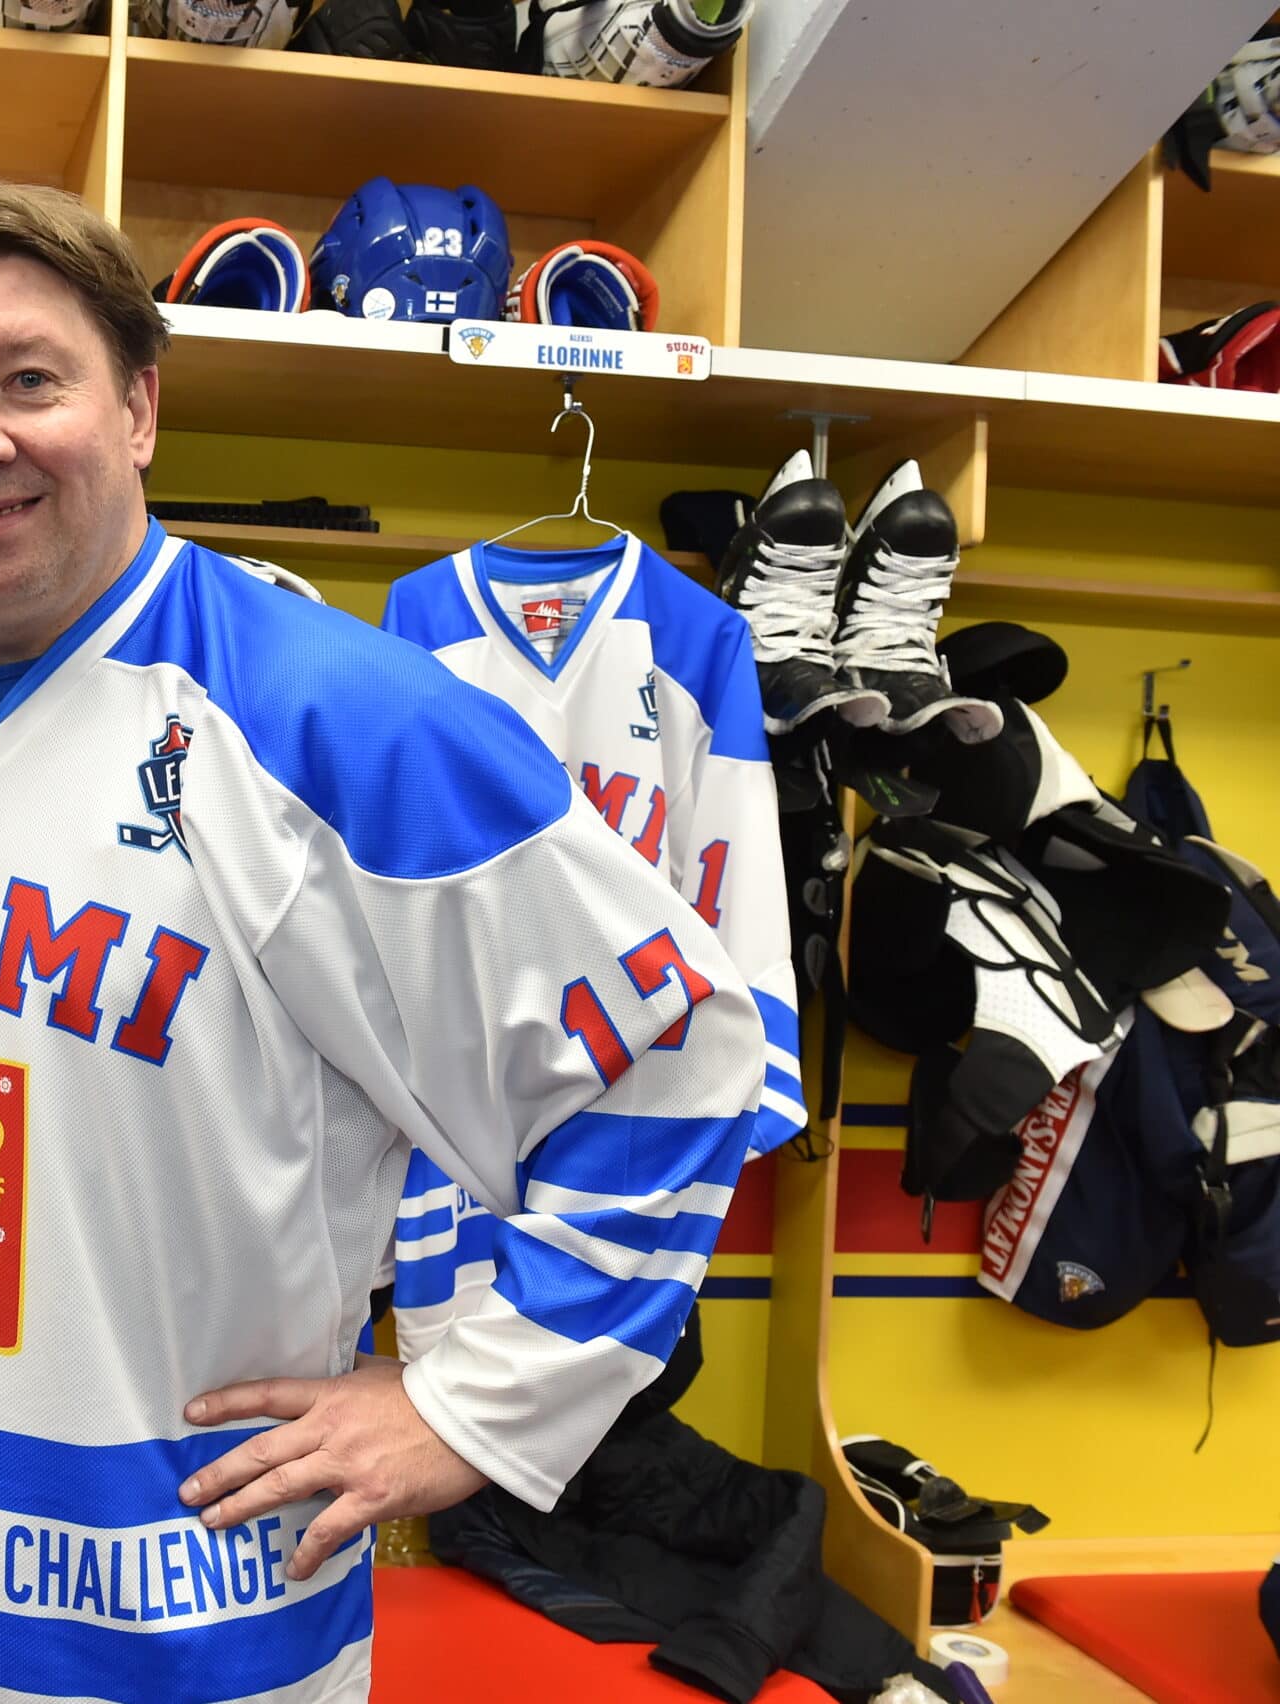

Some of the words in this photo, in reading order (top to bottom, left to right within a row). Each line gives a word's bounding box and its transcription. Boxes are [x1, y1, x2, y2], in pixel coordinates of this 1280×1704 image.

[425, 227, 462, 257] 23
[537, 344, 623, 369] ELORINNE
[666, 342, 705, 356] SUOMI
[690, 839, 730, 928] 1
[560, 927, 714, 1089] 17
[4, 1516, 287, 1622] CHALLENGE
